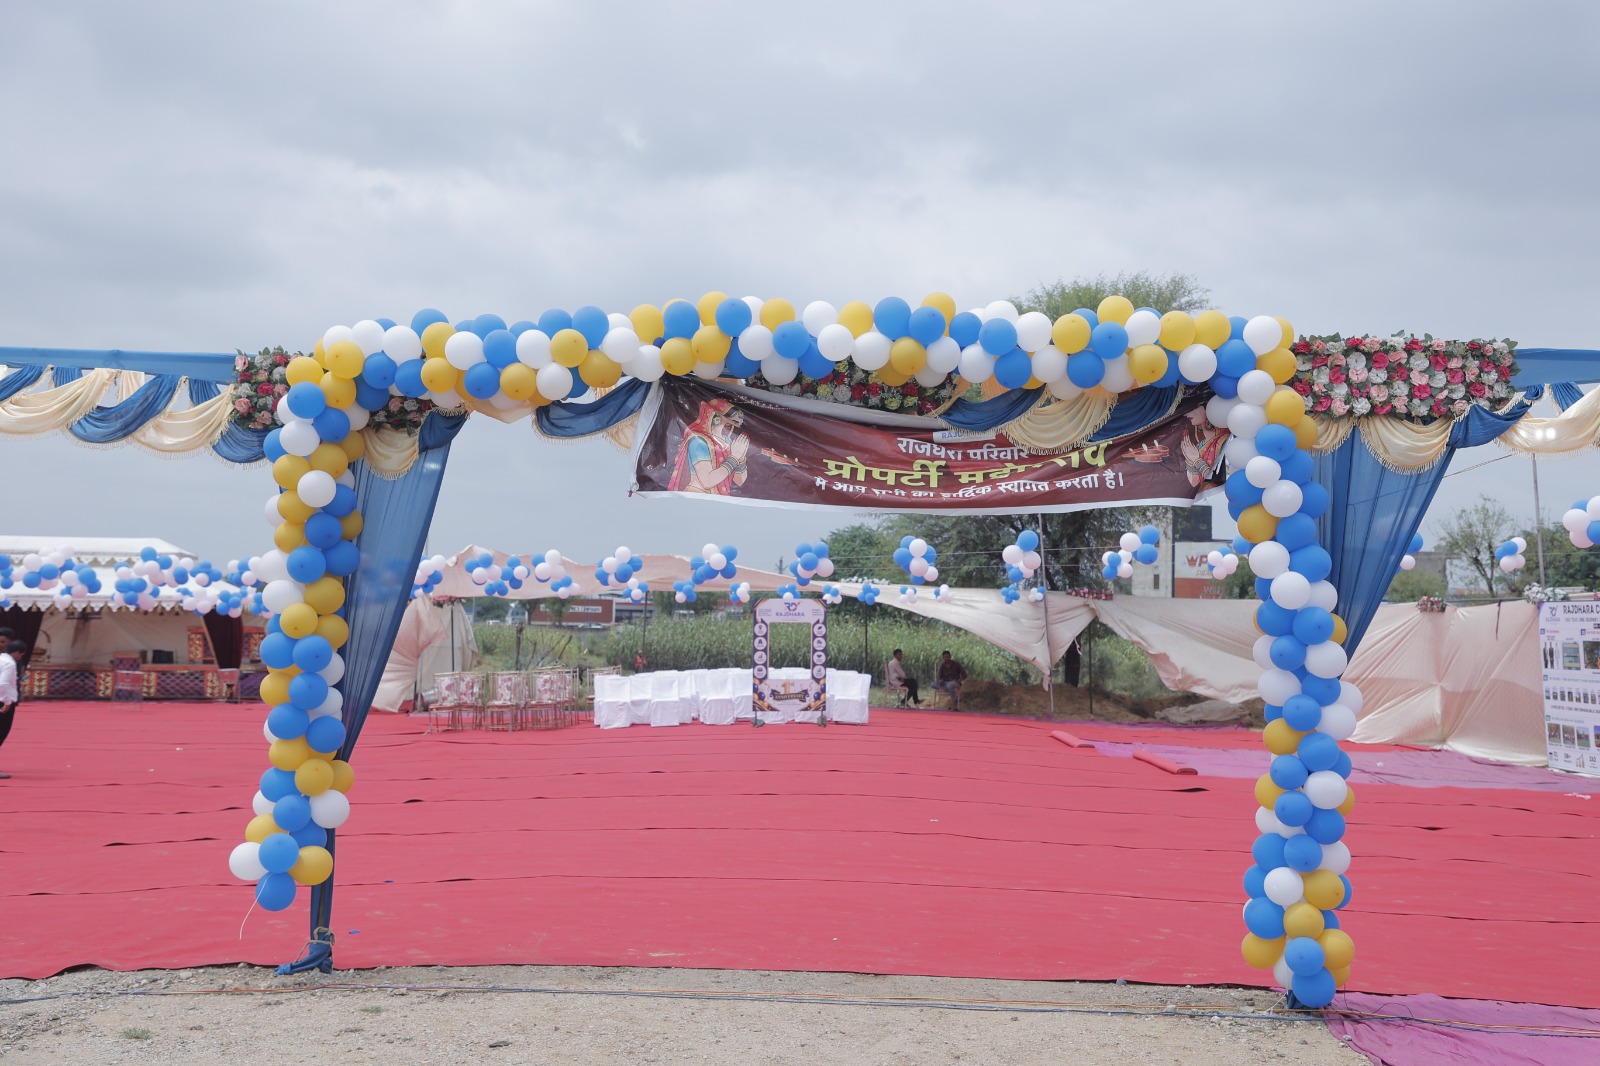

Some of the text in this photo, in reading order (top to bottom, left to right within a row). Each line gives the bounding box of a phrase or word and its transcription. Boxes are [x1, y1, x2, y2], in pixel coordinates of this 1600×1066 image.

[967, 443, 1029, 461] परिवार
[822, 456, 947, 488] प्रोपर्टी
[996, 479, 1050, 493] स्वागत
[1053, 472, 1100, 491] करता
[1563, 604, 1594, 615] RAJDHARA
